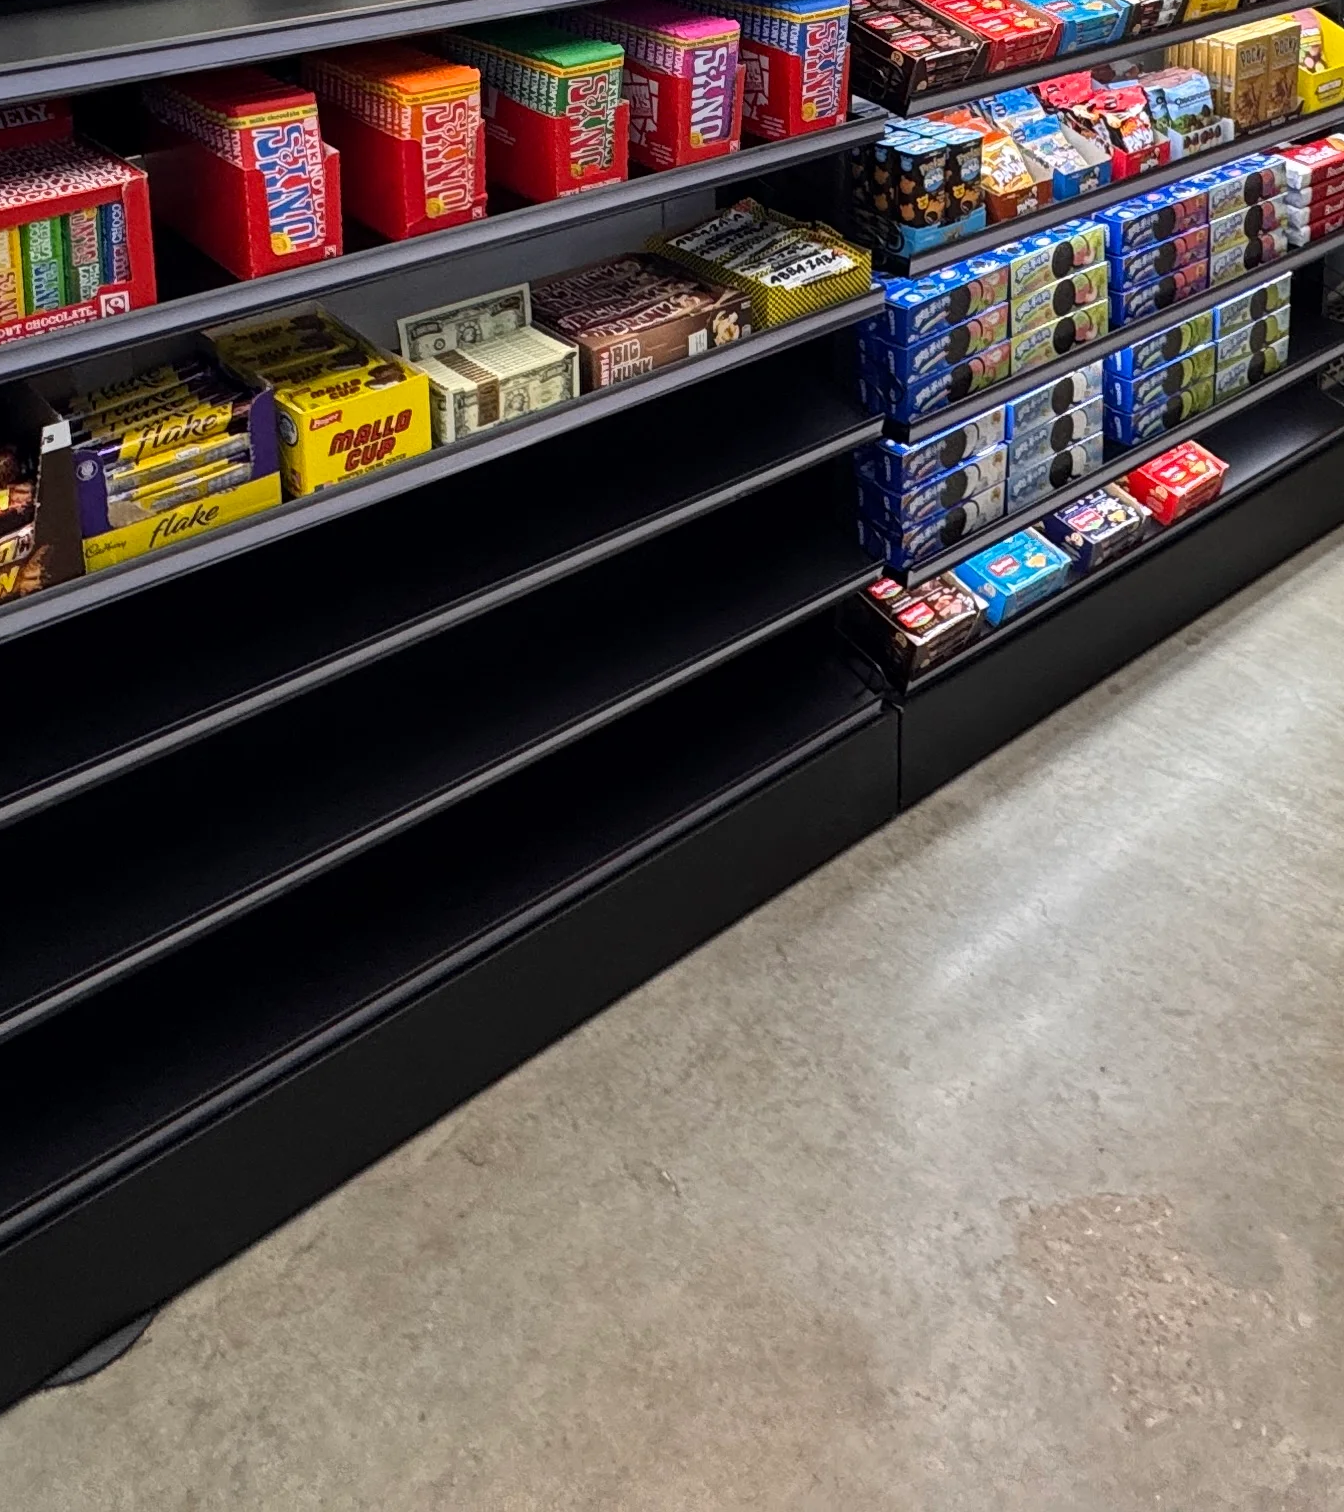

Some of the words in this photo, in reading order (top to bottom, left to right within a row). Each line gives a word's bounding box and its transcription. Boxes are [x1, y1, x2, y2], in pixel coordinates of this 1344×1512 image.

[1240, 45, 1267, 68] POCKY
[25, 306, 97, 331] CHOCOLATE.
[610, 339, 641, 367] BIG
[610, 355, 654, 386] HUNK
[136, 412, 218, 467] flake
[328, 408, 413, 457] MALLO
[344, 436, 397, 472] CUP
[149, 504, 220, 549] flake
